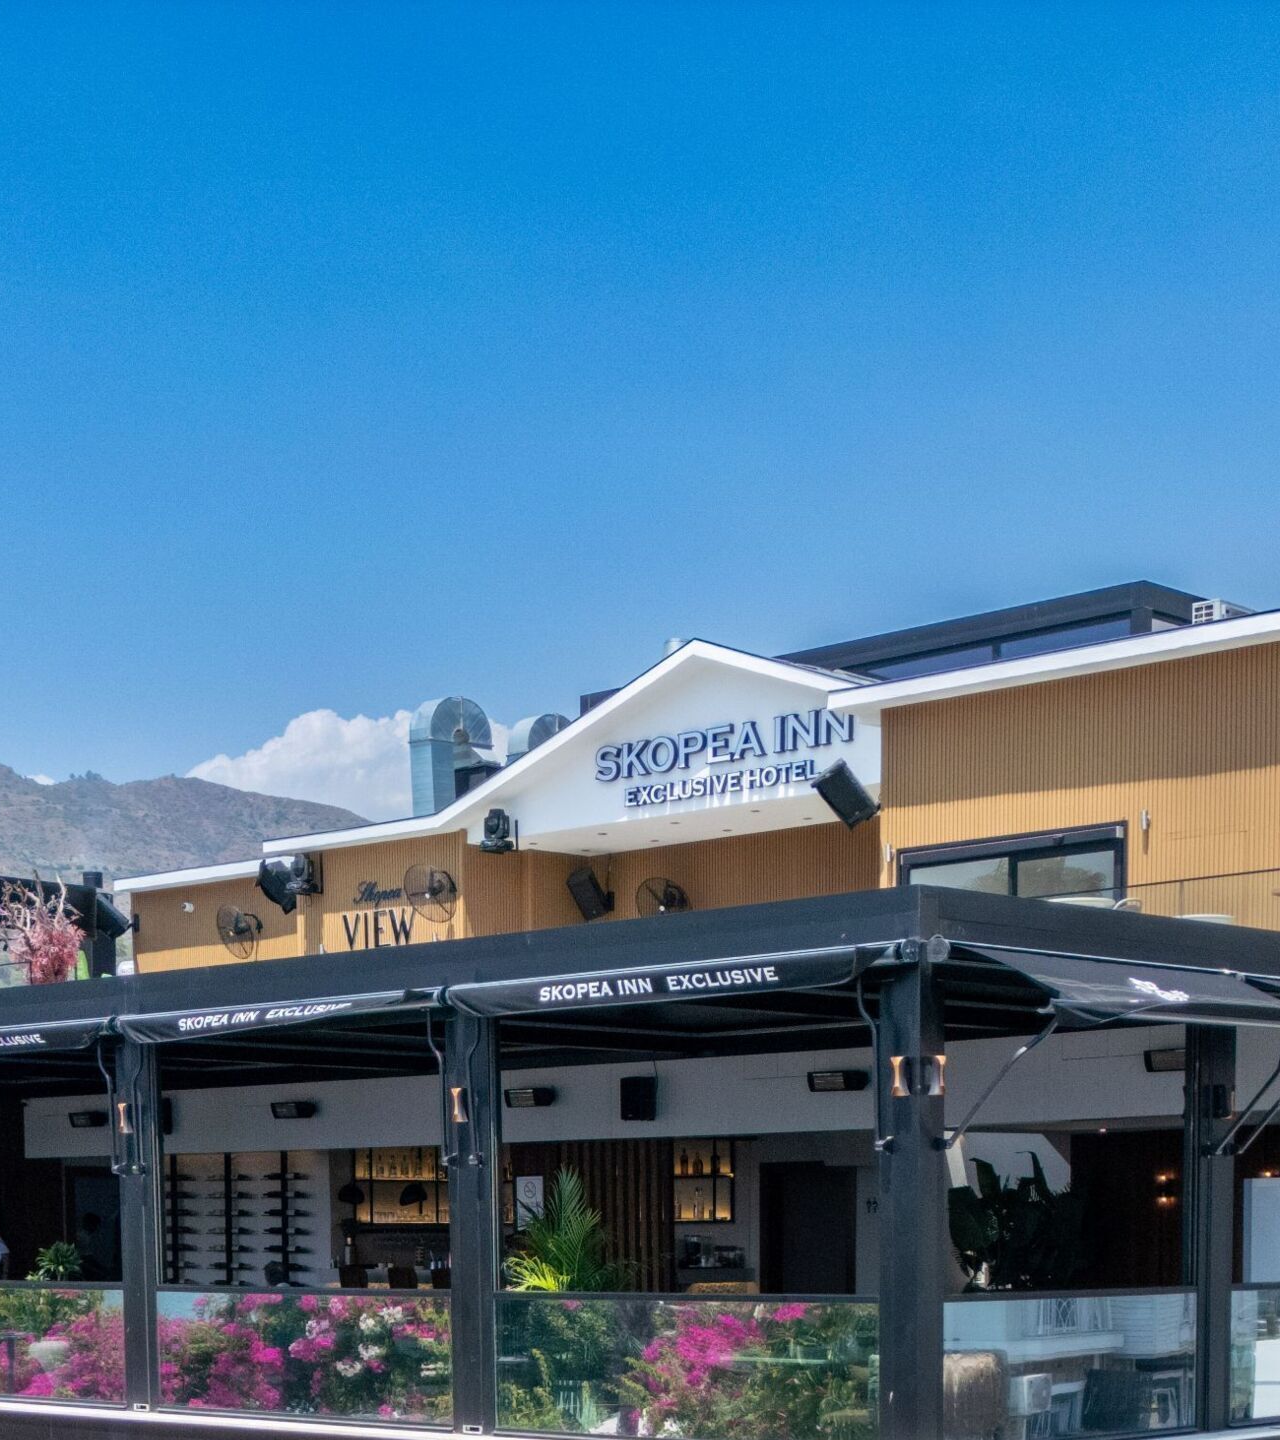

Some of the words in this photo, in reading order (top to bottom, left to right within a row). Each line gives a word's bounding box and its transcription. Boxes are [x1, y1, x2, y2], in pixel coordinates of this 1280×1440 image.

[595, 721, 767, 782] SKOPEA
[773, 708, 854, 754] INN
[624, 771, 745, 807] EXCLUSIVE
[745, 759, 819, 790] HOTEL
[343, 908, 415, 950] VIEW
[539, 981, 614, 1002] SKOPEA
[616, 977, 653, 995] INN
[666, 966, 779, 991] EXCLUSIVE
[177, 1013, 229, 1031] SKOPEA
[231, 1010, 261, 1025] INN
